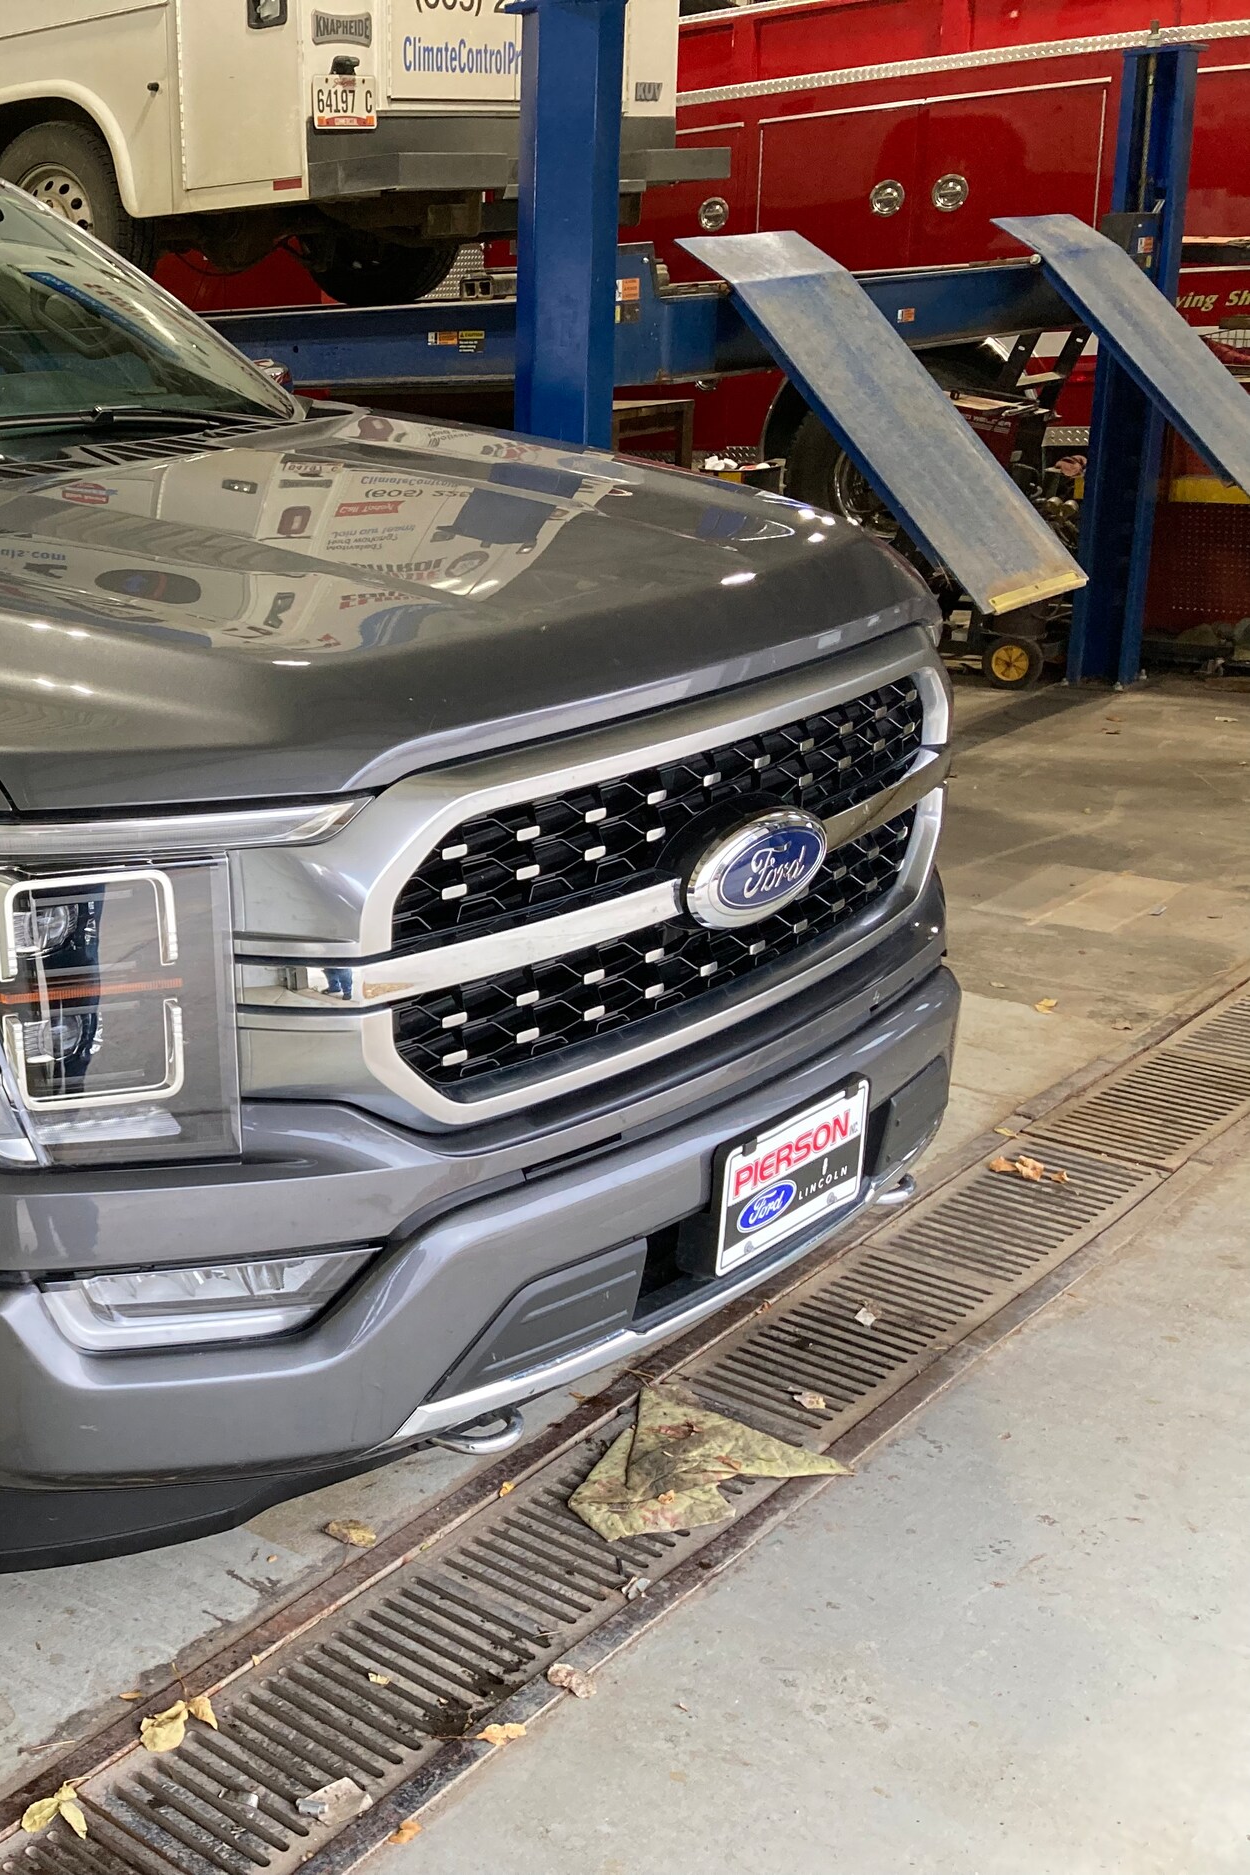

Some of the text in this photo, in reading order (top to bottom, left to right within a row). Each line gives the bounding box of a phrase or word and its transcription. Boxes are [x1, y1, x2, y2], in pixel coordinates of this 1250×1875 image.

[315, 14, 370, 40] KNAPHEIDE
[317, 89, 373, 113] 64197 C
[635, 82, 663, 101] KUV
[743, 841, 807, 899] Ford
[732, 1109, 850, 1199] PIERSON
[798, 1165, 848, 1201] LINCOLN
[748, 1188, 785, 1225] Ford
